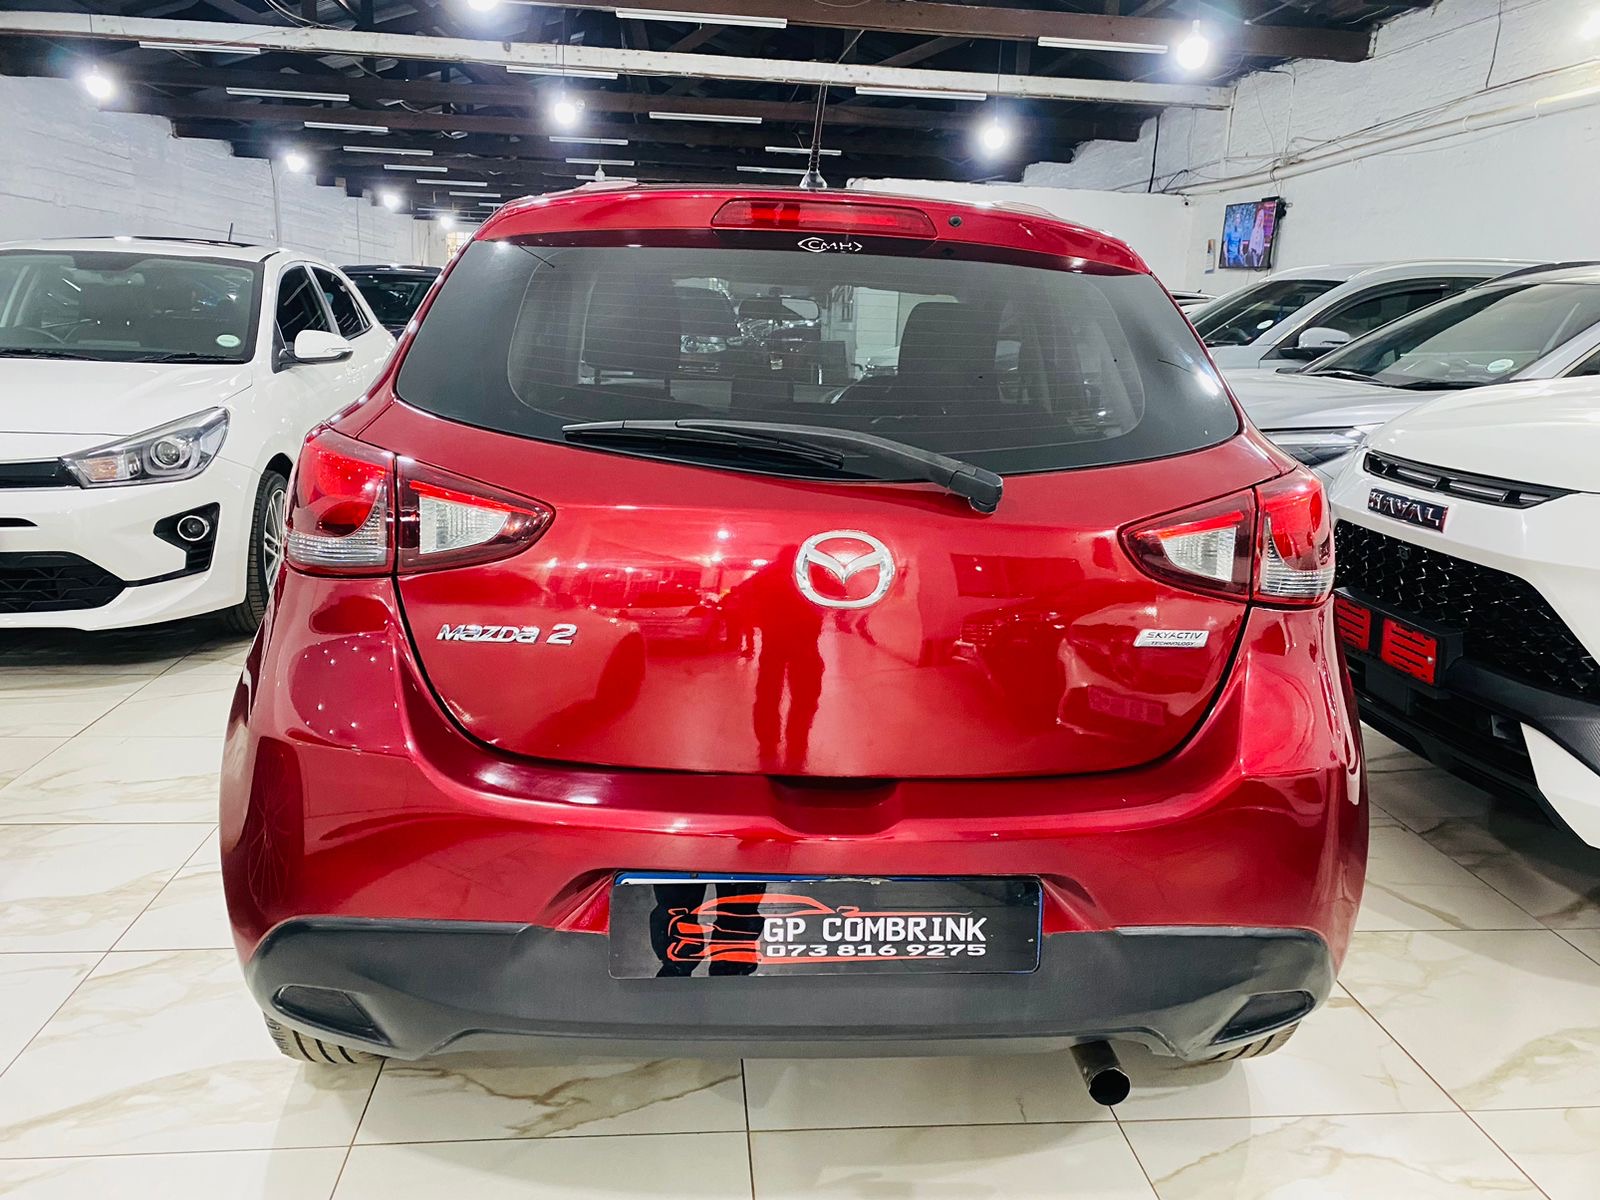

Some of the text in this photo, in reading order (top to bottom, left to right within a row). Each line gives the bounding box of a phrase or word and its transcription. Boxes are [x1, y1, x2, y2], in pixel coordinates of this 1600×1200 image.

[807, 239, 854, 251] CMH
[546, 623, 578, 645] 2
[1146, 631, 1203, 640] SKYACTIV
[763, 917, 988, 943] GP COMBRINK
[766, 944, 987, 957] 073 816 9275
